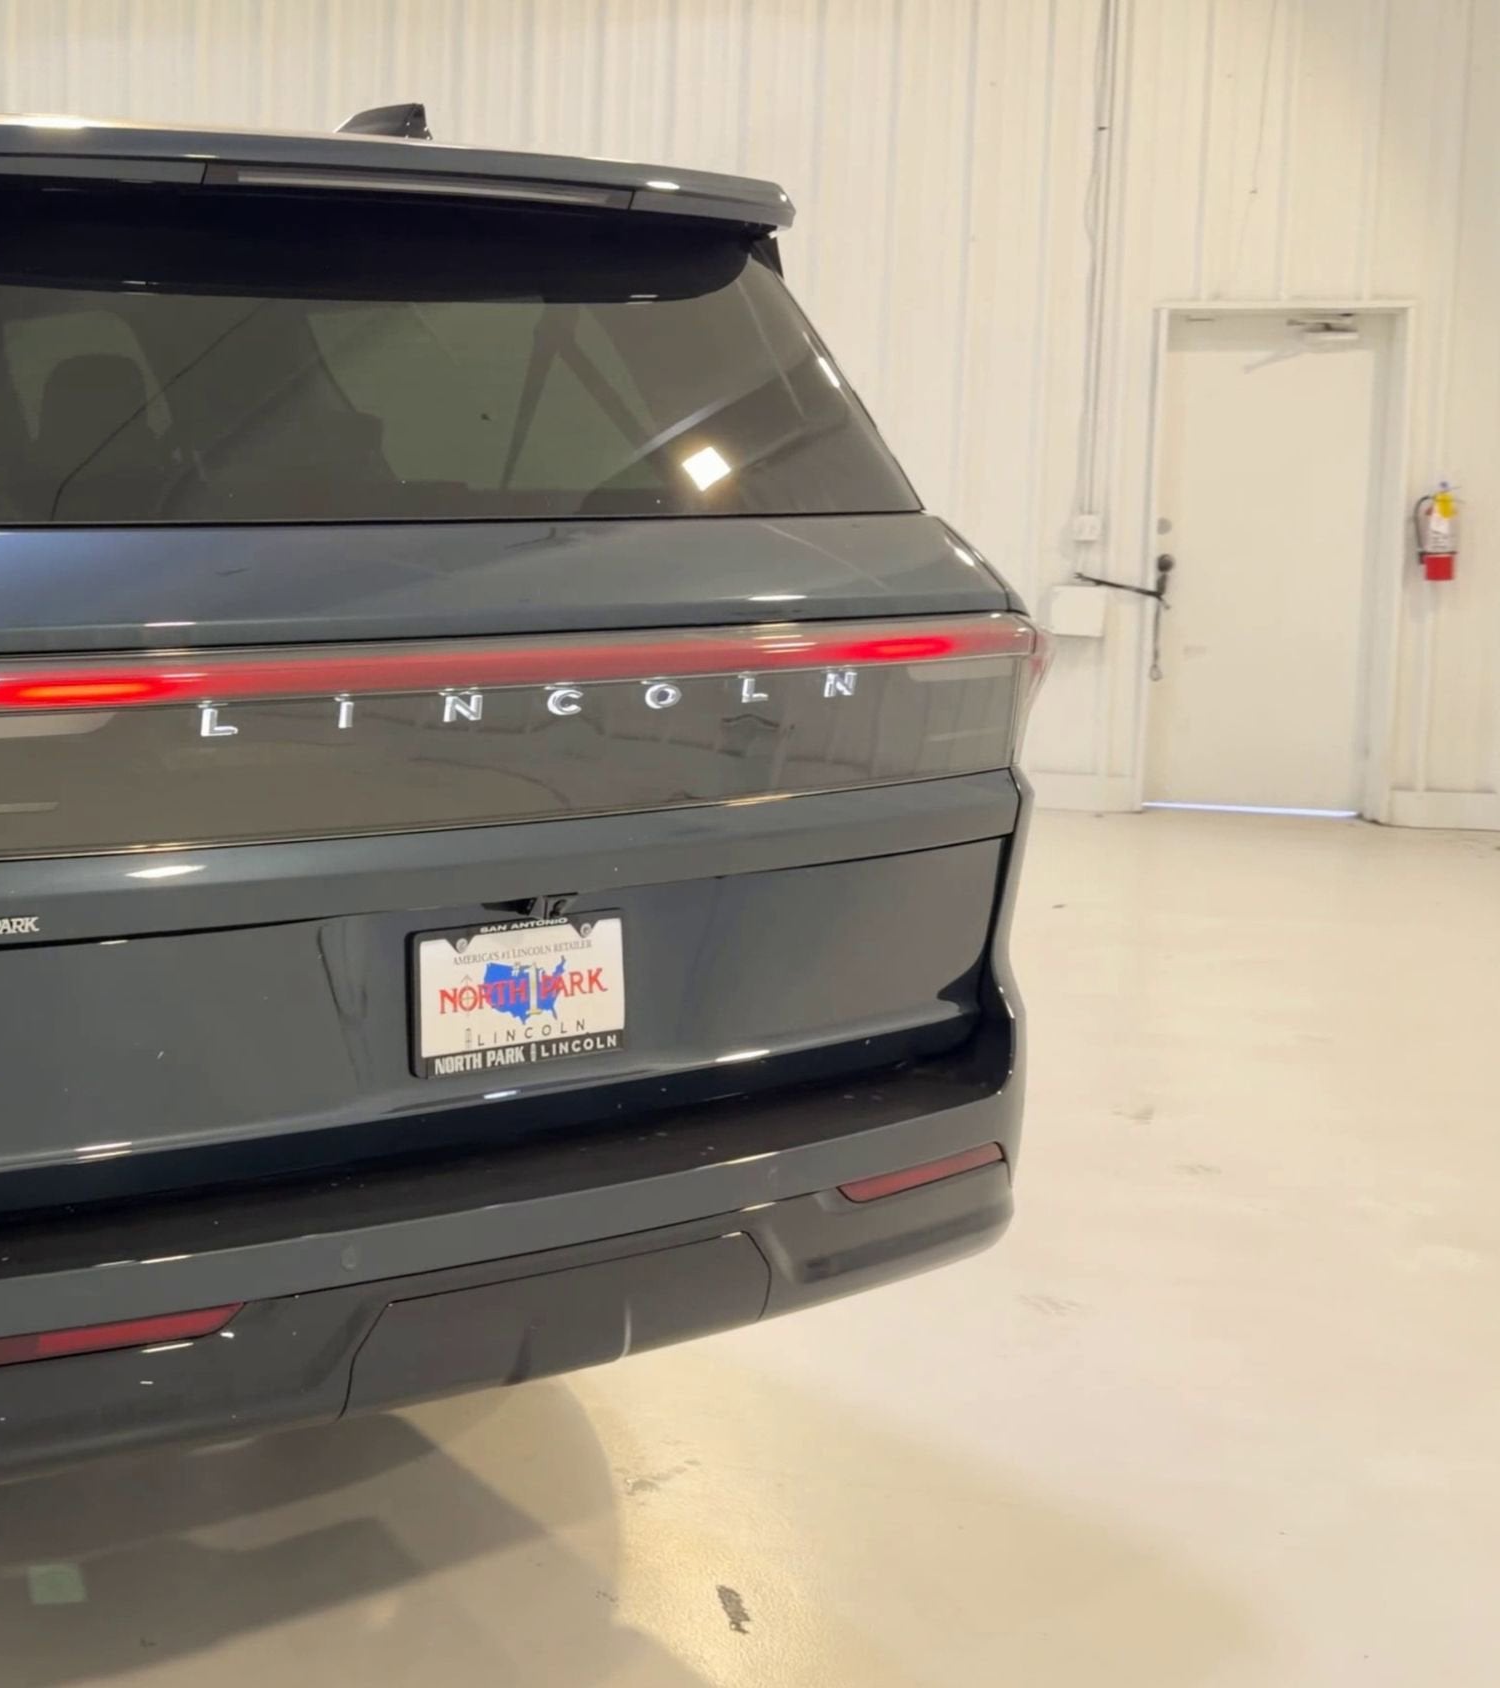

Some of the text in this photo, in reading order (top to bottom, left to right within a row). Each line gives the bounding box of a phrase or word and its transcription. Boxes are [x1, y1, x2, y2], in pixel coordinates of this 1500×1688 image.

[200, 667, 856, 737] LINCOLN
[480, 917, 569, 934] SAN ANTONIO
[453, 951, 500, 966] AMERICA'S
[512, 943, 551, 959] LINCOLN
[553, 939, 592, 952] RETAILER
[438, 967, 609, 1015] NORTH PARK
[477, 1018, 585, 1047] LINCOLN
[434, 1034, 617, 1075] NORTH PARK LINCOLN
